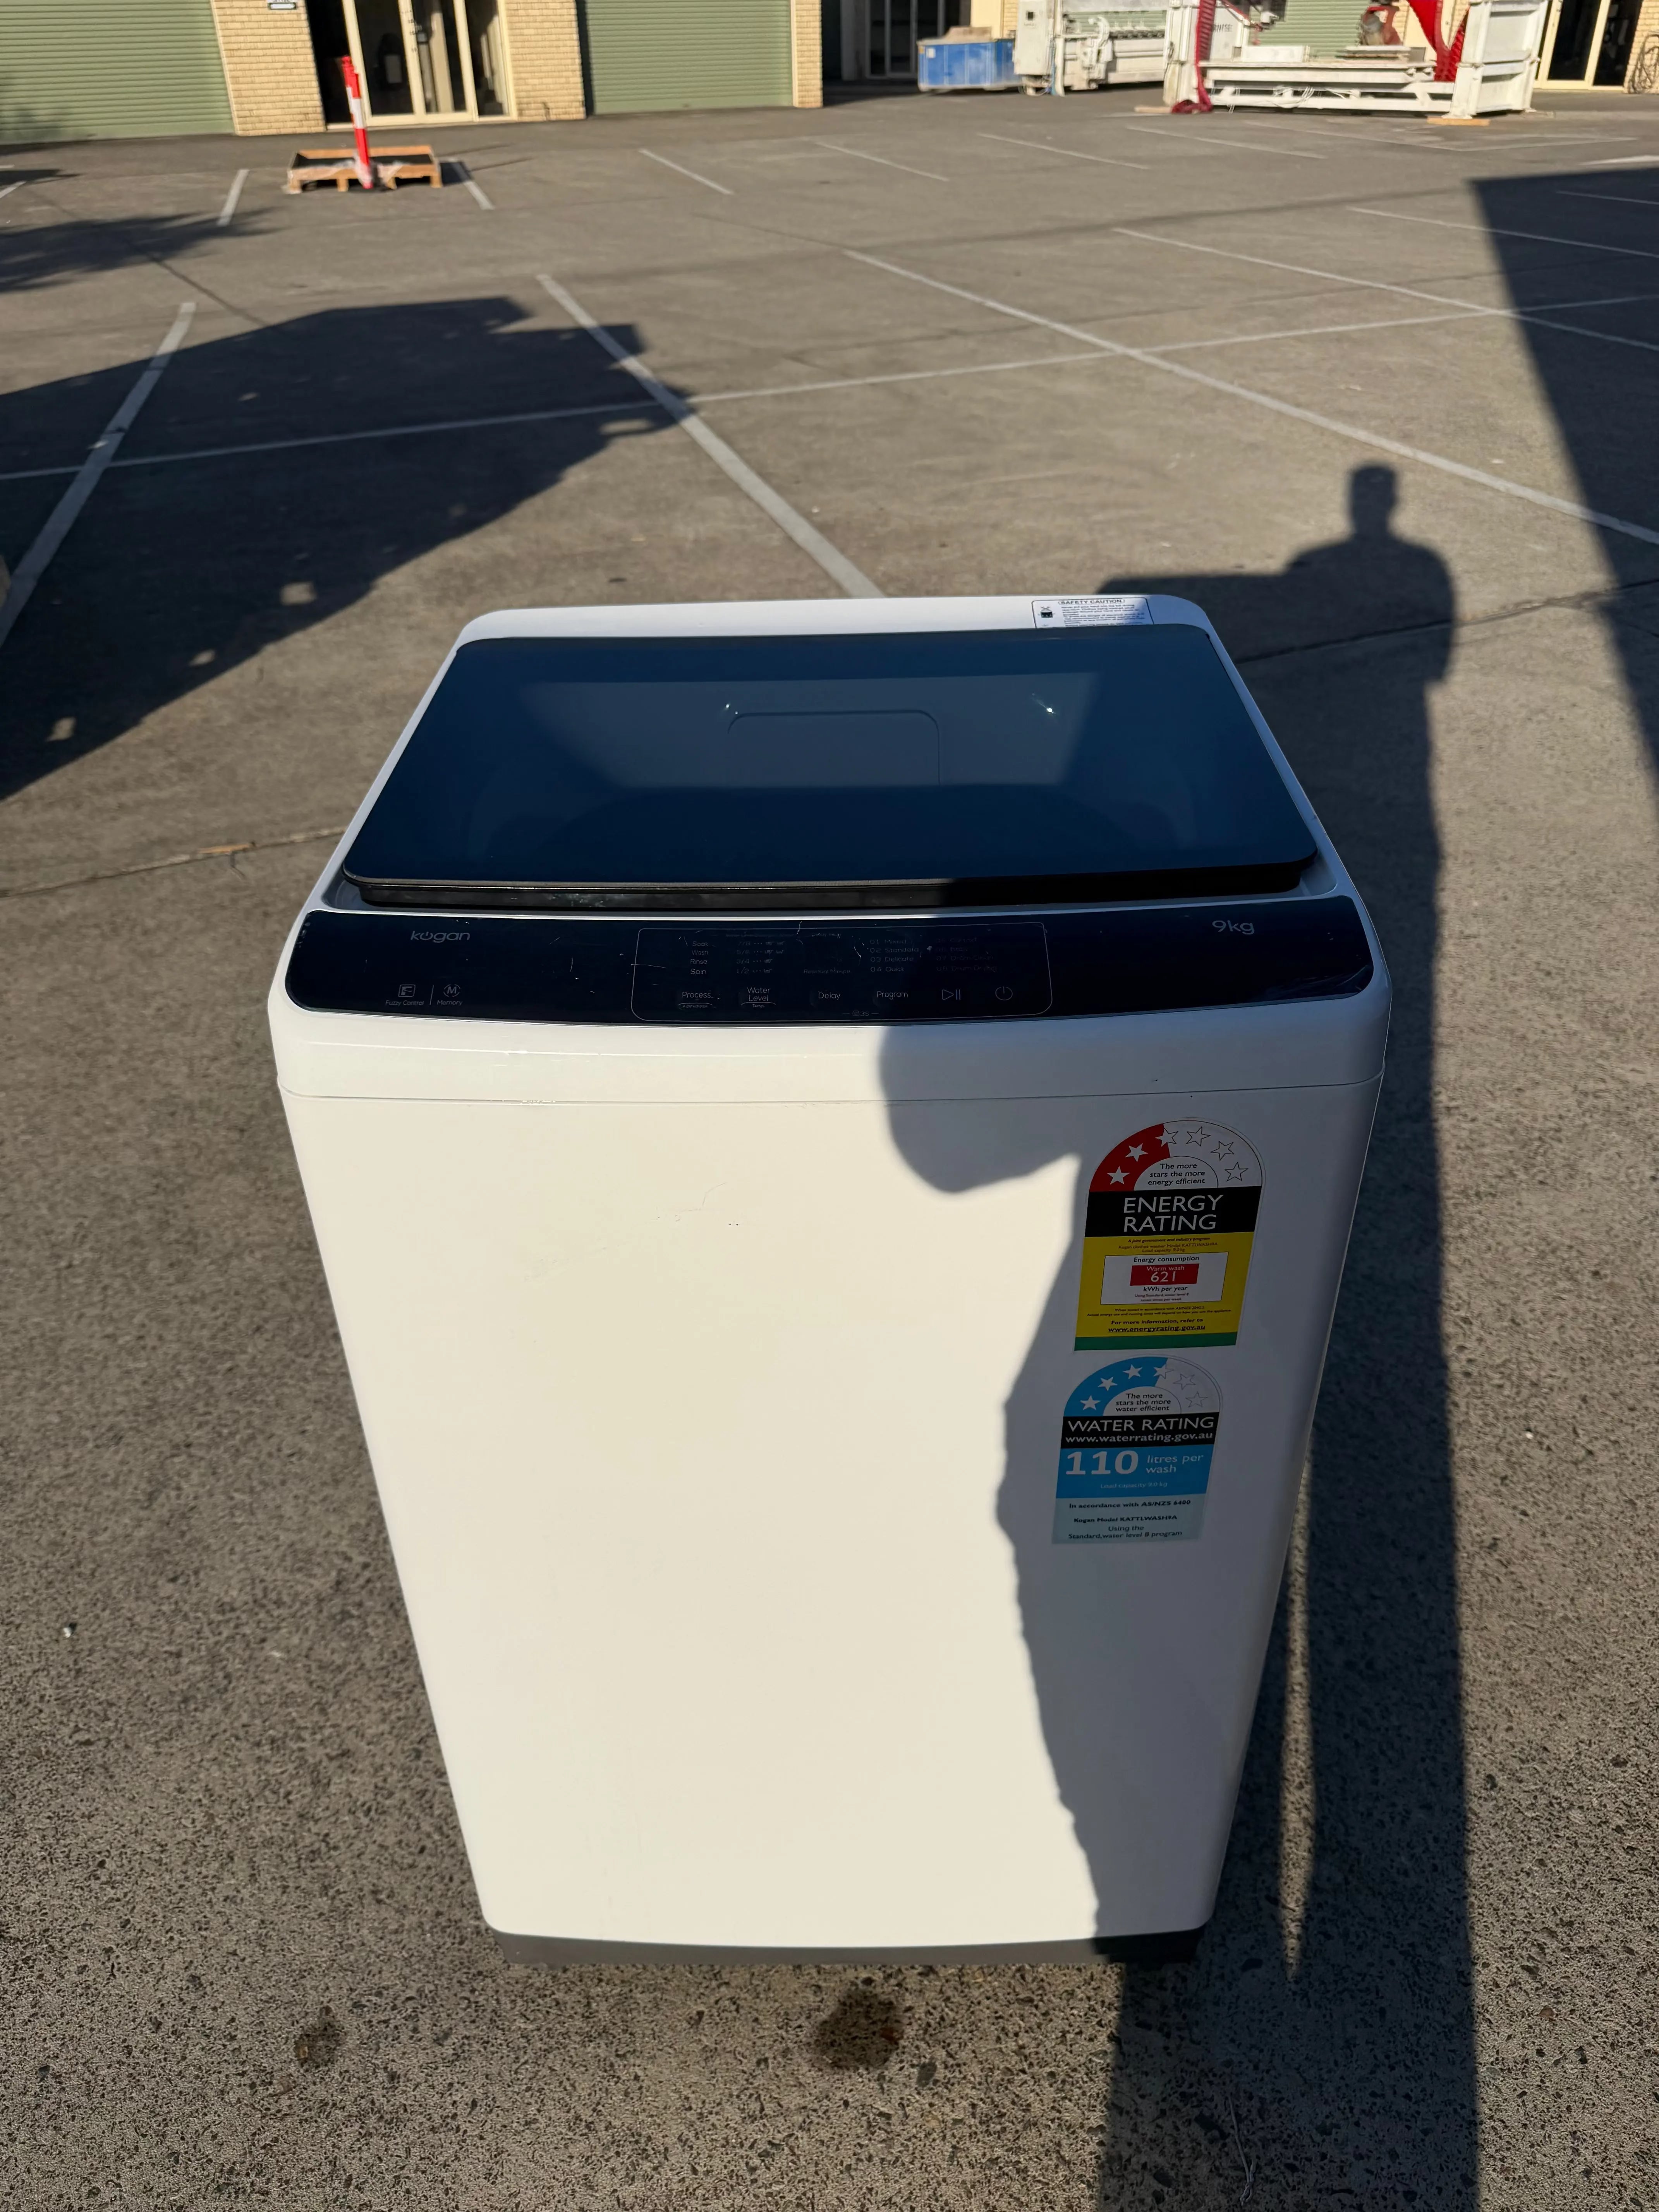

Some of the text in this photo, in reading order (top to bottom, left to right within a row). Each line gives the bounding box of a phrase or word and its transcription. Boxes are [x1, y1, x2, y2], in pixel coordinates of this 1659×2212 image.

[1212, 920, 1255, 935] 9kg
[410, 931, 470, 943] kogan
[818, 992, 841, 1000] Delay
[877, 991, 908, 1000] Program
[1123, 1195, 1224, 1213] ENERGY
[1124, 1214, 1217, 1232] RATING
[1151, 1271, 1176, 1282] 621
[1068, 1417, 1214, 1432] WATER RATING
[1065, 1432, 1213, 1443] www.waterrating.gov.au
[1066, 1450, 1204, 1475] 110 litres per
[1146, 1465, 1176, 1473] wash
